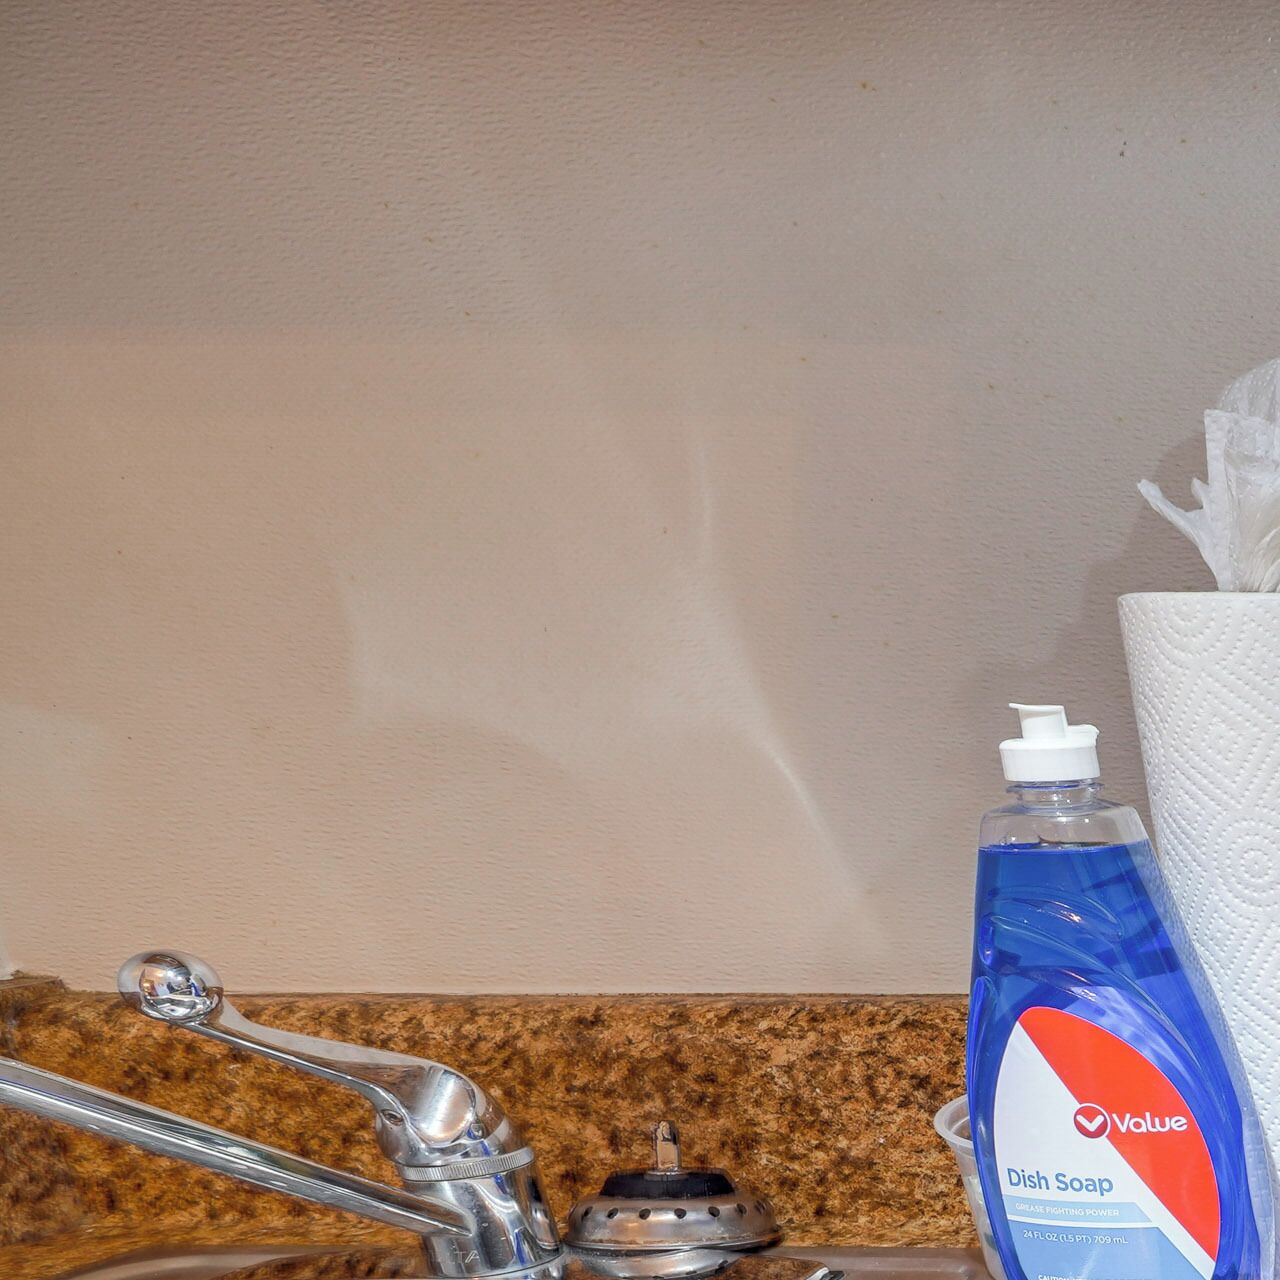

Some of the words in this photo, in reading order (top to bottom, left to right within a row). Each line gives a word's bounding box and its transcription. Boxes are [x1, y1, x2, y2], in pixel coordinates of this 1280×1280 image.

[1111, 1112, 1188, 1134] Value
[1007, 1168, 1050, 1191] Dish
[1054, 1172, 1114, 1196] Soap
[1015, 1202, 1045, 1214] GREASE
[1046, 1205, 1084, 1216] FIGHTING
[1085, 1208, 1120, 1217] POWER
[1023, 1229, 1033, 1239] 24
[1034, 1231, 1045, 1240] FL
[1045, 1232, 1058, 1241] OZ
[1076, 1235, 1092, 1244] PT)
[1094, 1236, 1111, 1245] 709
[1112, 1236, 1128, 1244] mL
